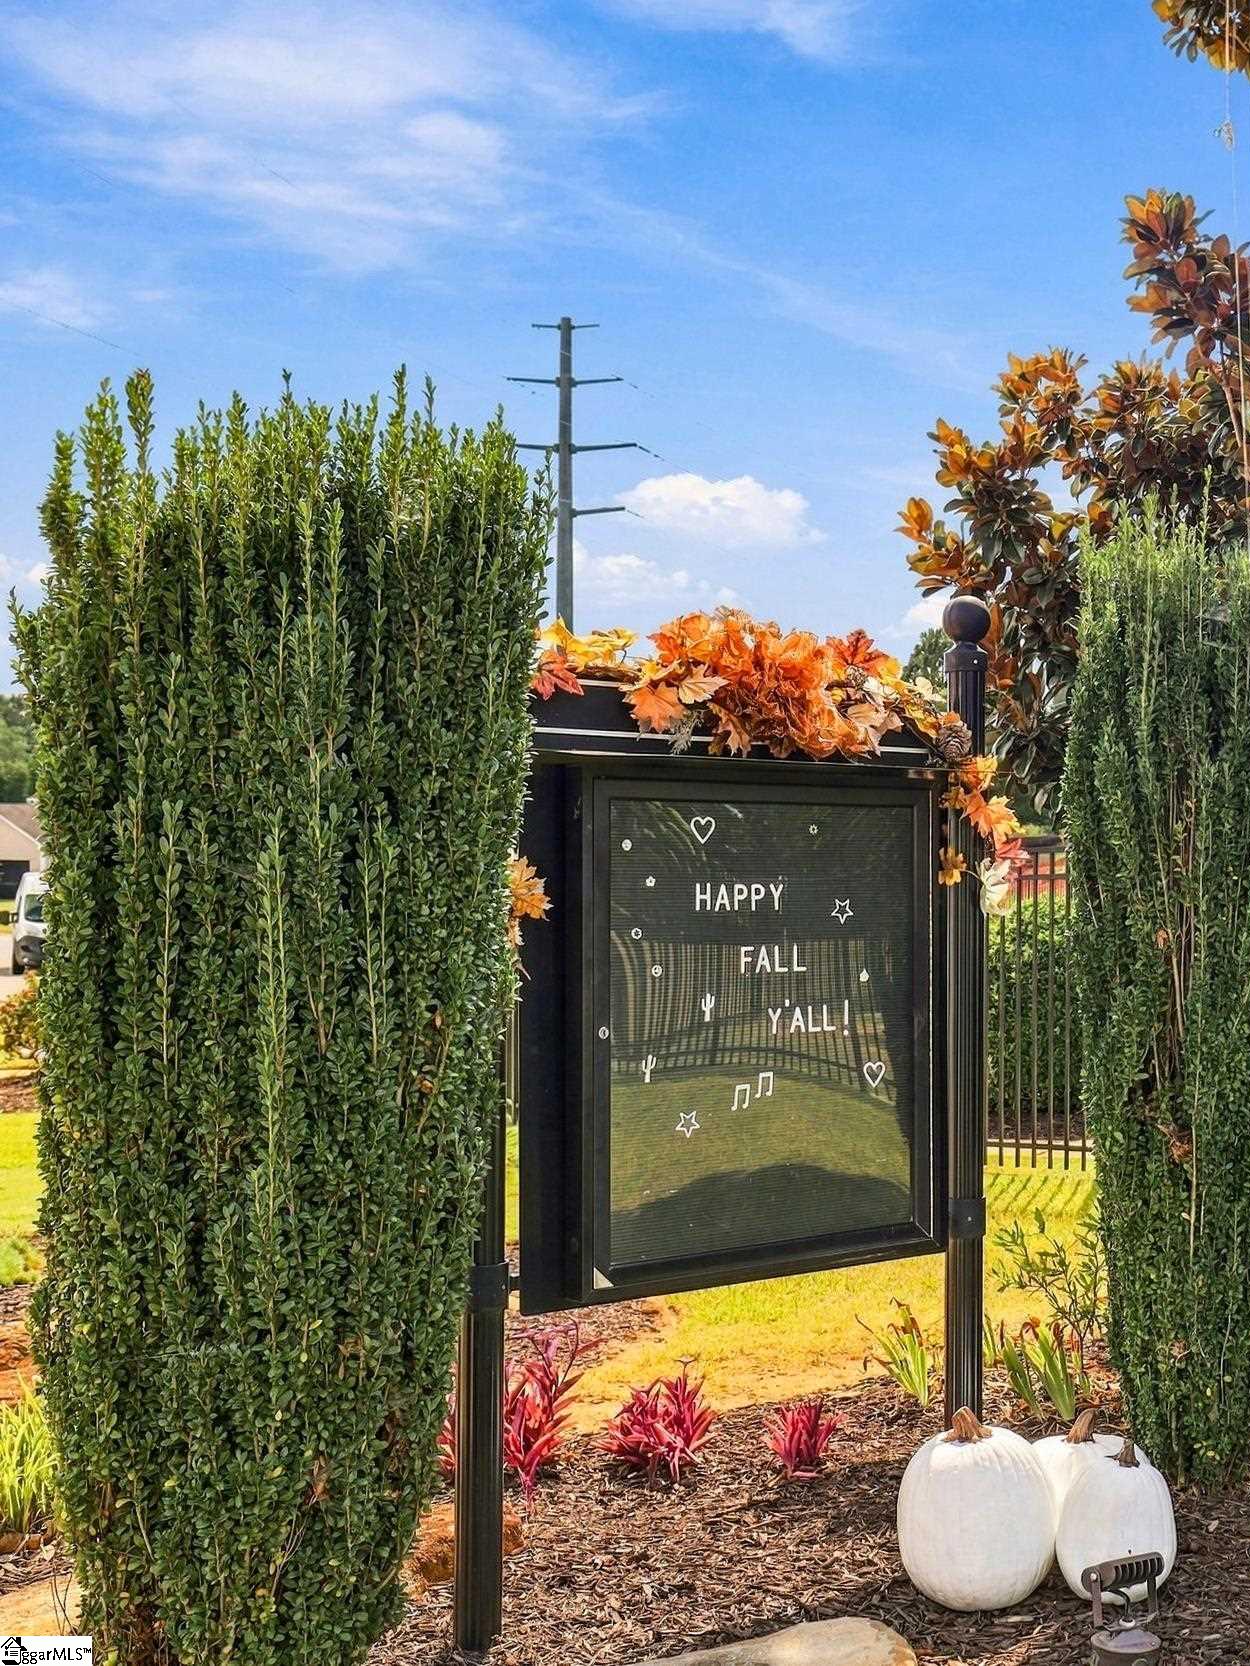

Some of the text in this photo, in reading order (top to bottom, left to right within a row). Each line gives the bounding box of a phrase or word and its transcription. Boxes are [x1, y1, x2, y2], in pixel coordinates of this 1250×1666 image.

[695, 882, 784, 912] HAPPY
[740, 943, 807, 974] FALL
[767, 999, 850, 1036] Y'ALL!
